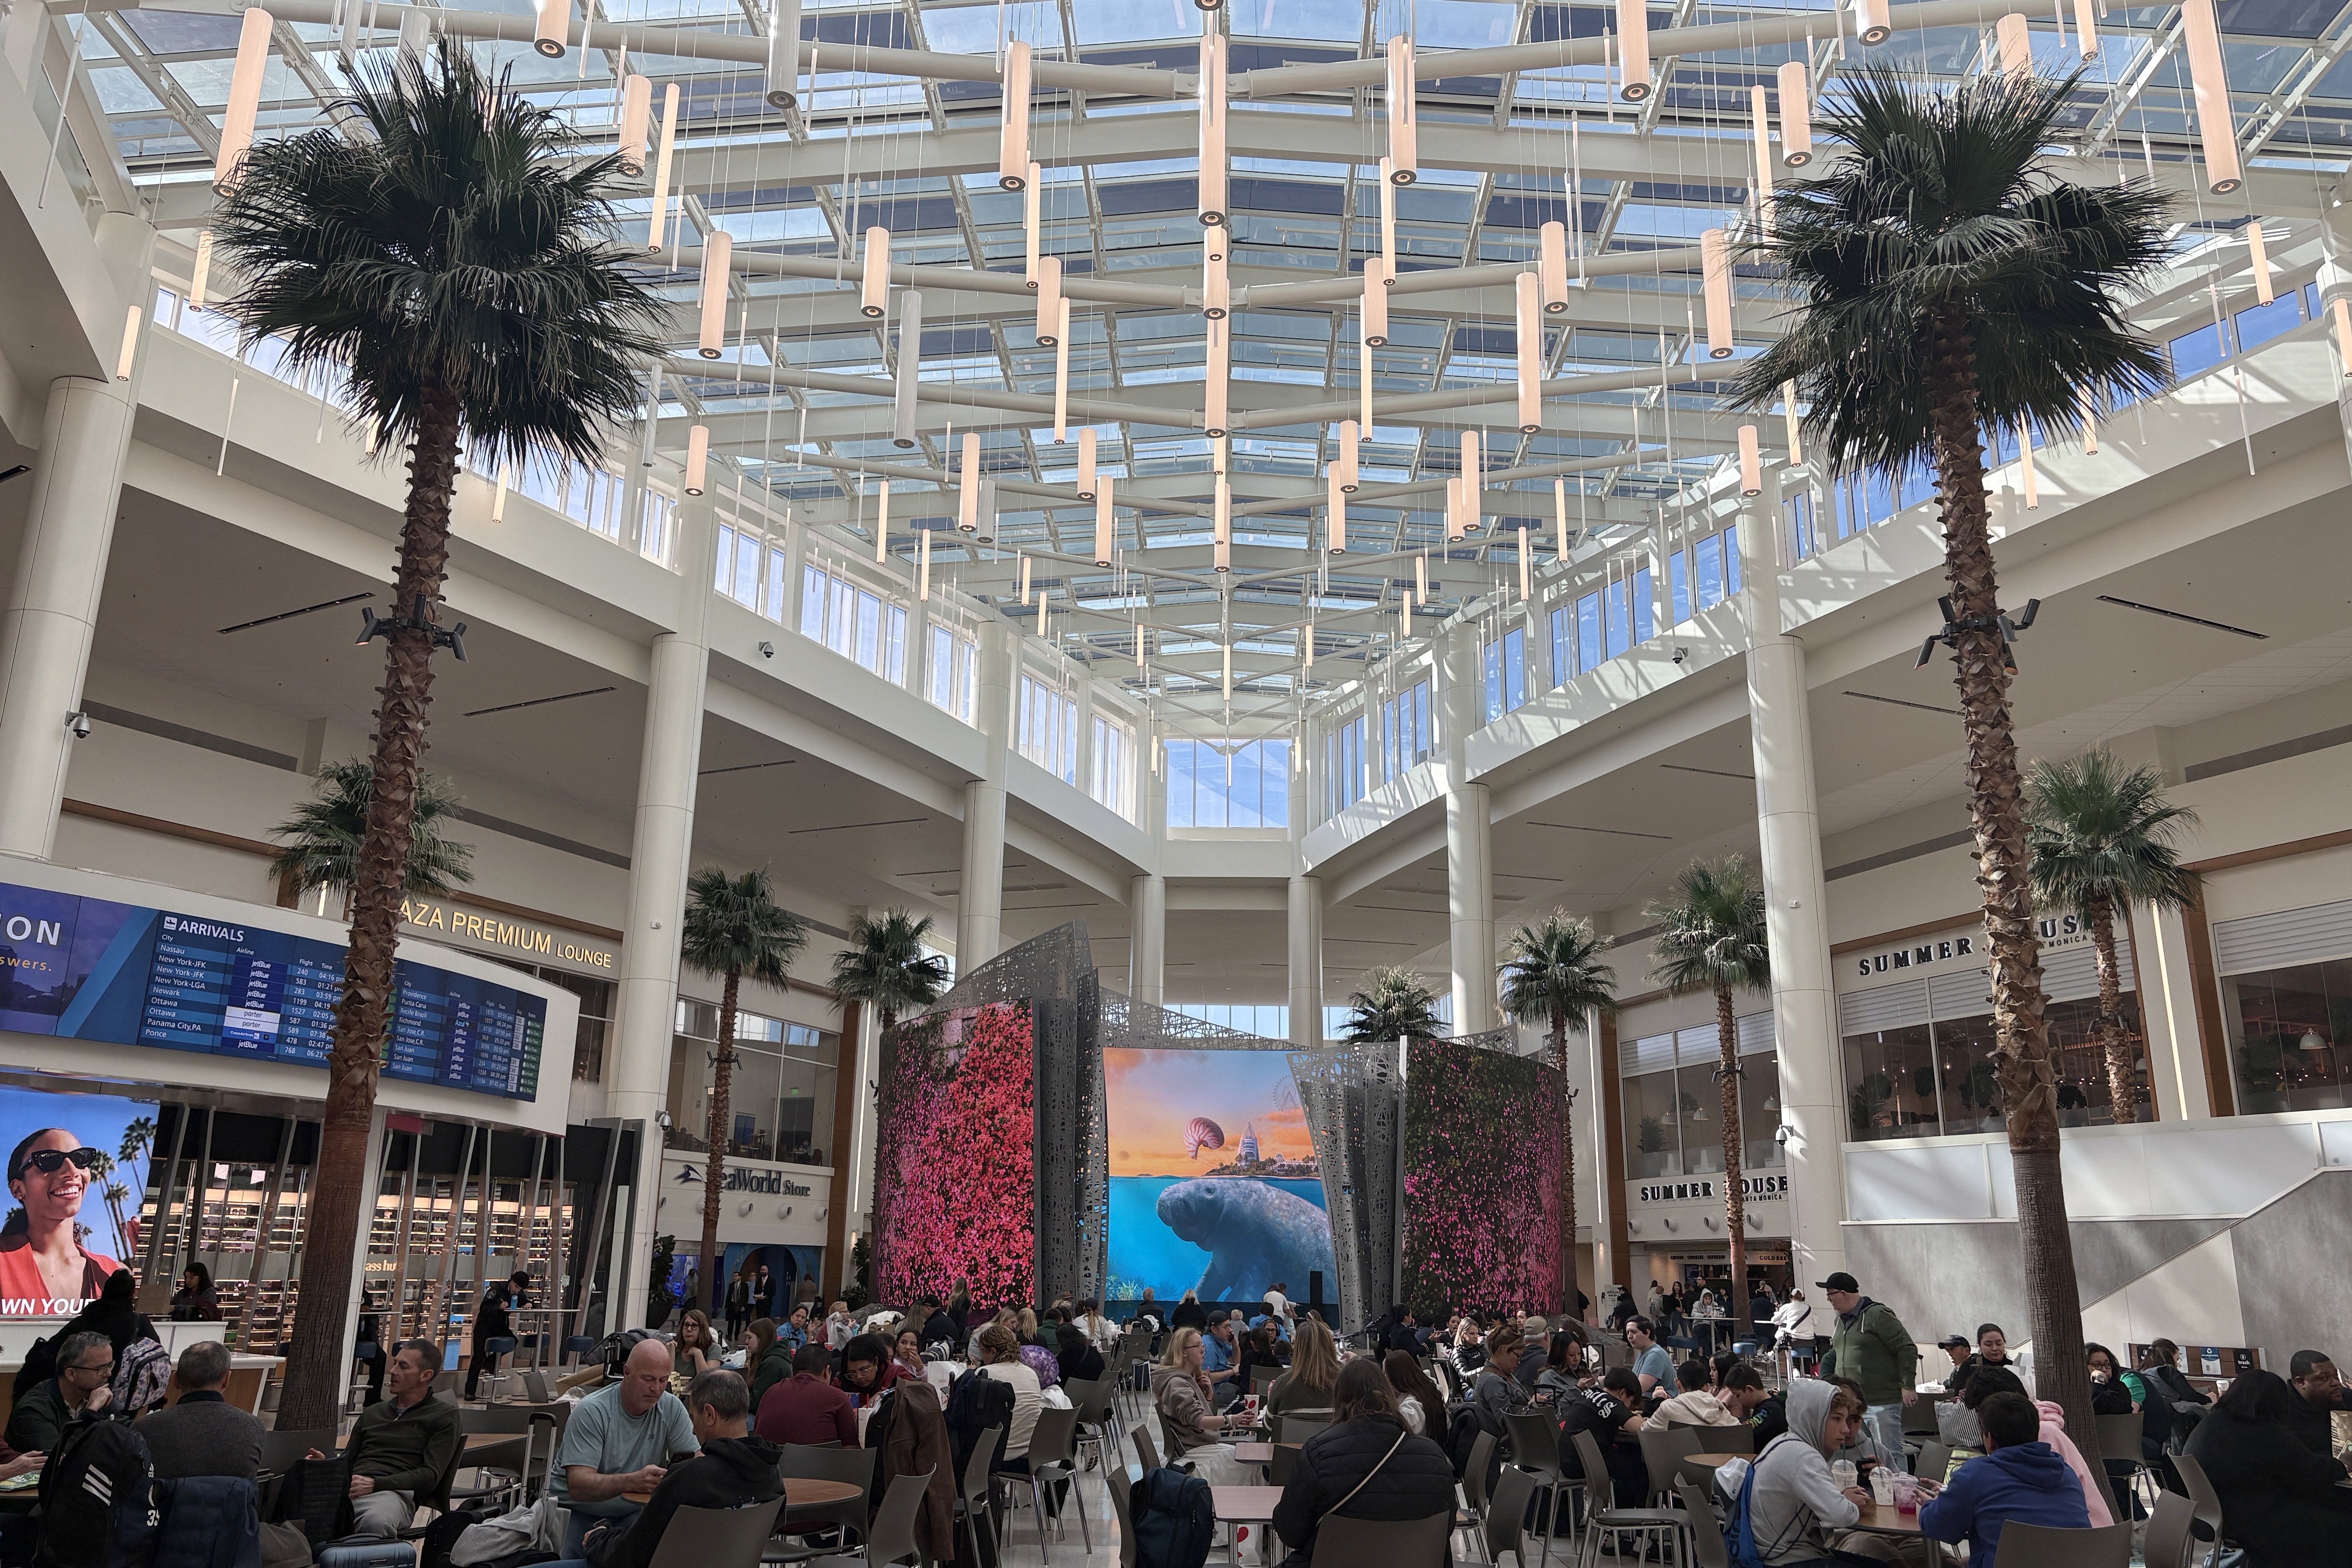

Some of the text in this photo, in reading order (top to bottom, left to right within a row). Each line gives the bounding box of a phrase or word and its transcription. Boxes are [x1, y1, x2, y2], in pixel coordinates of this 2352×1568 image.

[0, 914, 61, 945] ON
[178, 920, 244, 942] ARRIVALS
[400, 899, 611, 968] AZA PREMIUM LOUNGE
[2039, 915, 2077, 938] US
[2049, 935, 2087, 947] MONICA
[0, 956, 51, 971] swers.
[161, 945, 184, 954] Nassau
[252, 959, 271, 969] jetBlue
[319, 973, 334, 981] 04:16
[1859, 938, 1973, 976] SUMMER
[175, 968, 204, 978] York-JFK
[248, 980, 268, 989] jetBlue
[316, 992, 331, 1000] 03:59
[177, 958, 206, 968] York-JFK
[250, 969, 269, 979] jetBlue
[317, 982, 333, 990] 01:21
[151, 997, 177, 1007] Ottawa
[153, 987, 180, 996] Newark
[245, 999, 264, 1008] jetBlue
[313, 1011, 329, 1019] 02:05
[155, 976, 171, 984] New
[173, 978, 205, 989] York-LGA
[246, 989, 266, 999] jetBlue
[315, 1001, 330, 1009] 04:19
[403, 989, 427, 1000] Providence
[147, 1018, 175, 1028] Panama
[177, 1022, 201, 1031] City,PA
[149, 1008, 176, 1017] Ottawa
[310, 1030, 325, 1038] 07:38
[399, 1017, 421, 1027] Richmond
[145, 1029, 167, 1037] Ponce
[238, 1040, 258, 1049] jetBlue
[307, 1050, 322, 1058] 06:23
[721, 1168, 810, 1196] eaWorld Store
[1641, 1176, 1787, 1201] SUMMER OUSE
[365, 1262, 382, 1271] ass
[2, 1298, 35, 1314] WN
